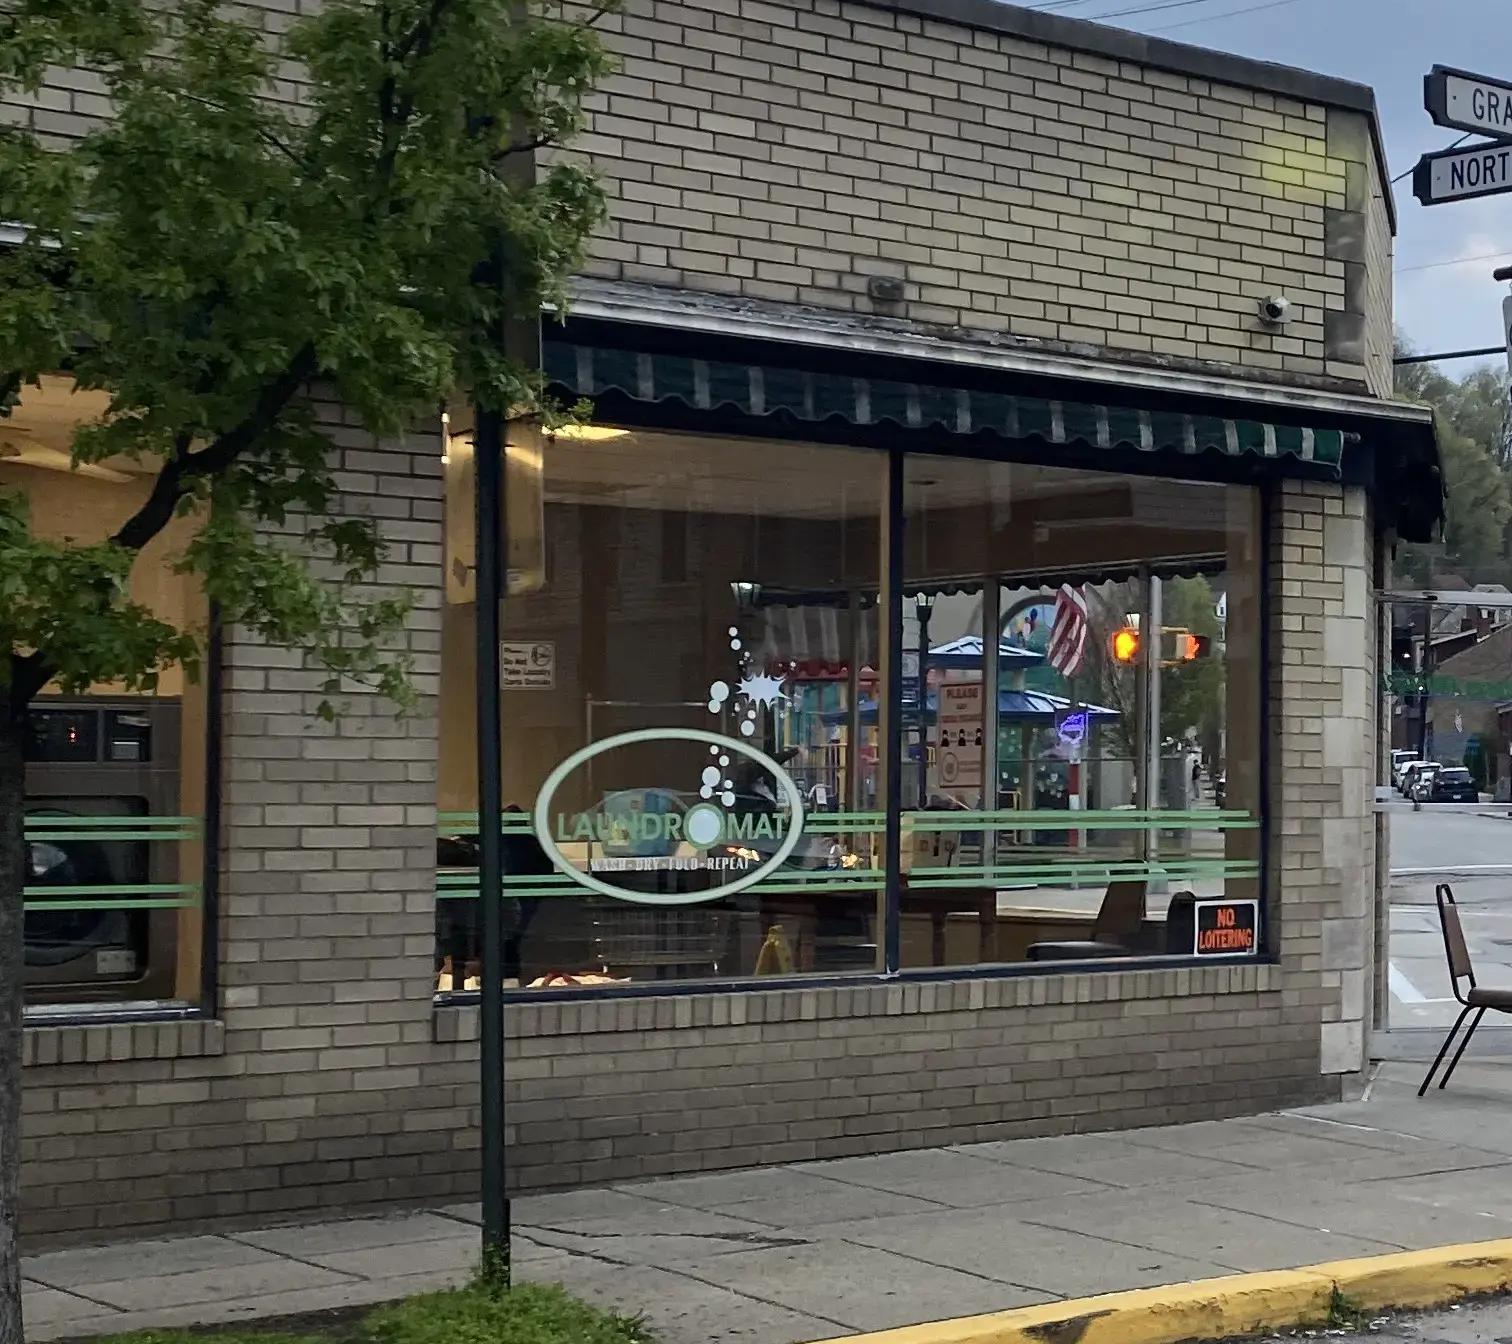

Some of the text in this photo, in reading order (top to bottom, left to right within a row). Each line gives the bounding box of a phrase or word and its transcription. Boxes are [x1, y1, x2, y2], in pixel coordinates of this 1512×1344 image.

[946, 687, 979, 699] PLEASE
[557, 804, 785, 848] LAUNDROMAT
[589, 856, 750, 872] WASH DRY FOLD REPEAT
[1216, 908, 1235, 928] NO
[1199, 928, 1253, 949] LOITERING
